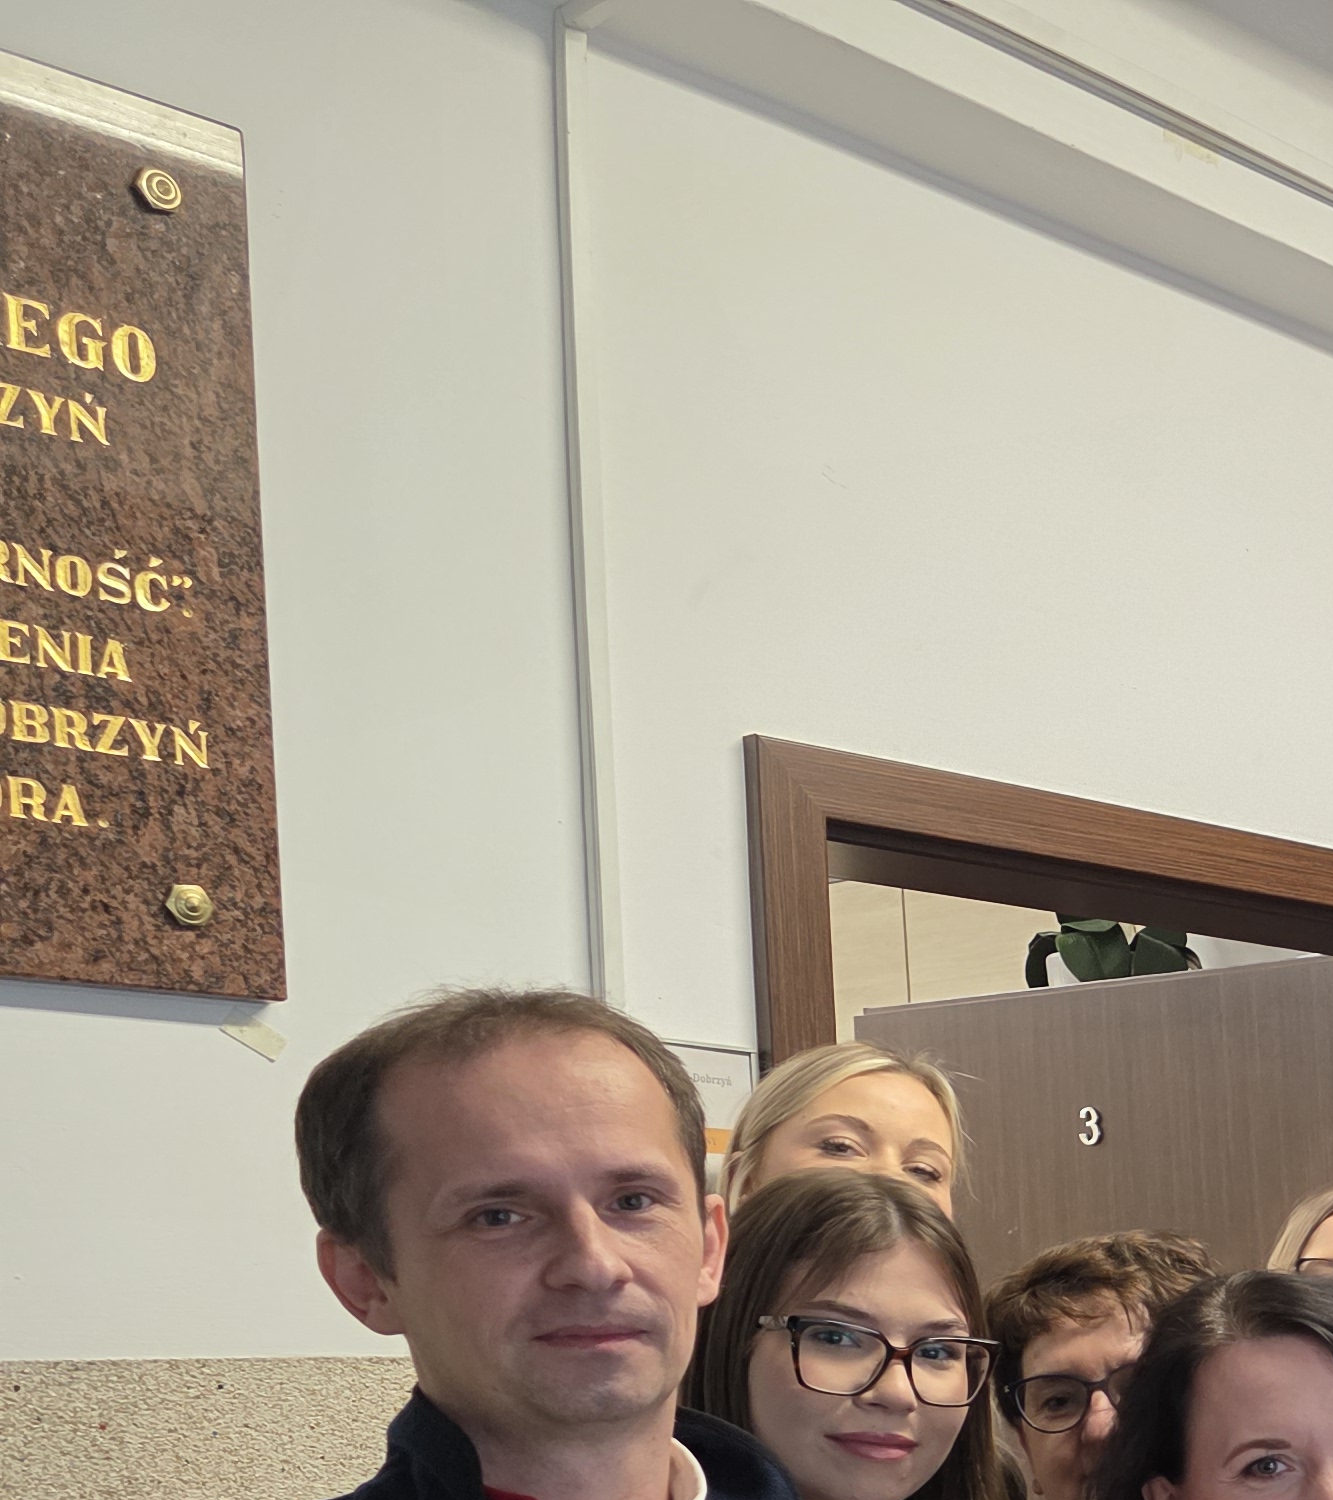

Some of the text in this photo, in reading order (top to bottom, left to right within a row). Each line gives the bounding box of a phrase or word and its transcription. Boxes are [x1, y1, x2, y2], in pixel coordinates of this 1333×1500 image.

[0, 291, 157, 383] EGO
[0, 698, 210, 769] BRZYŃ
[0, 775, 110, 828] RA.
[1078, 1106, 1101, 1146] 3
